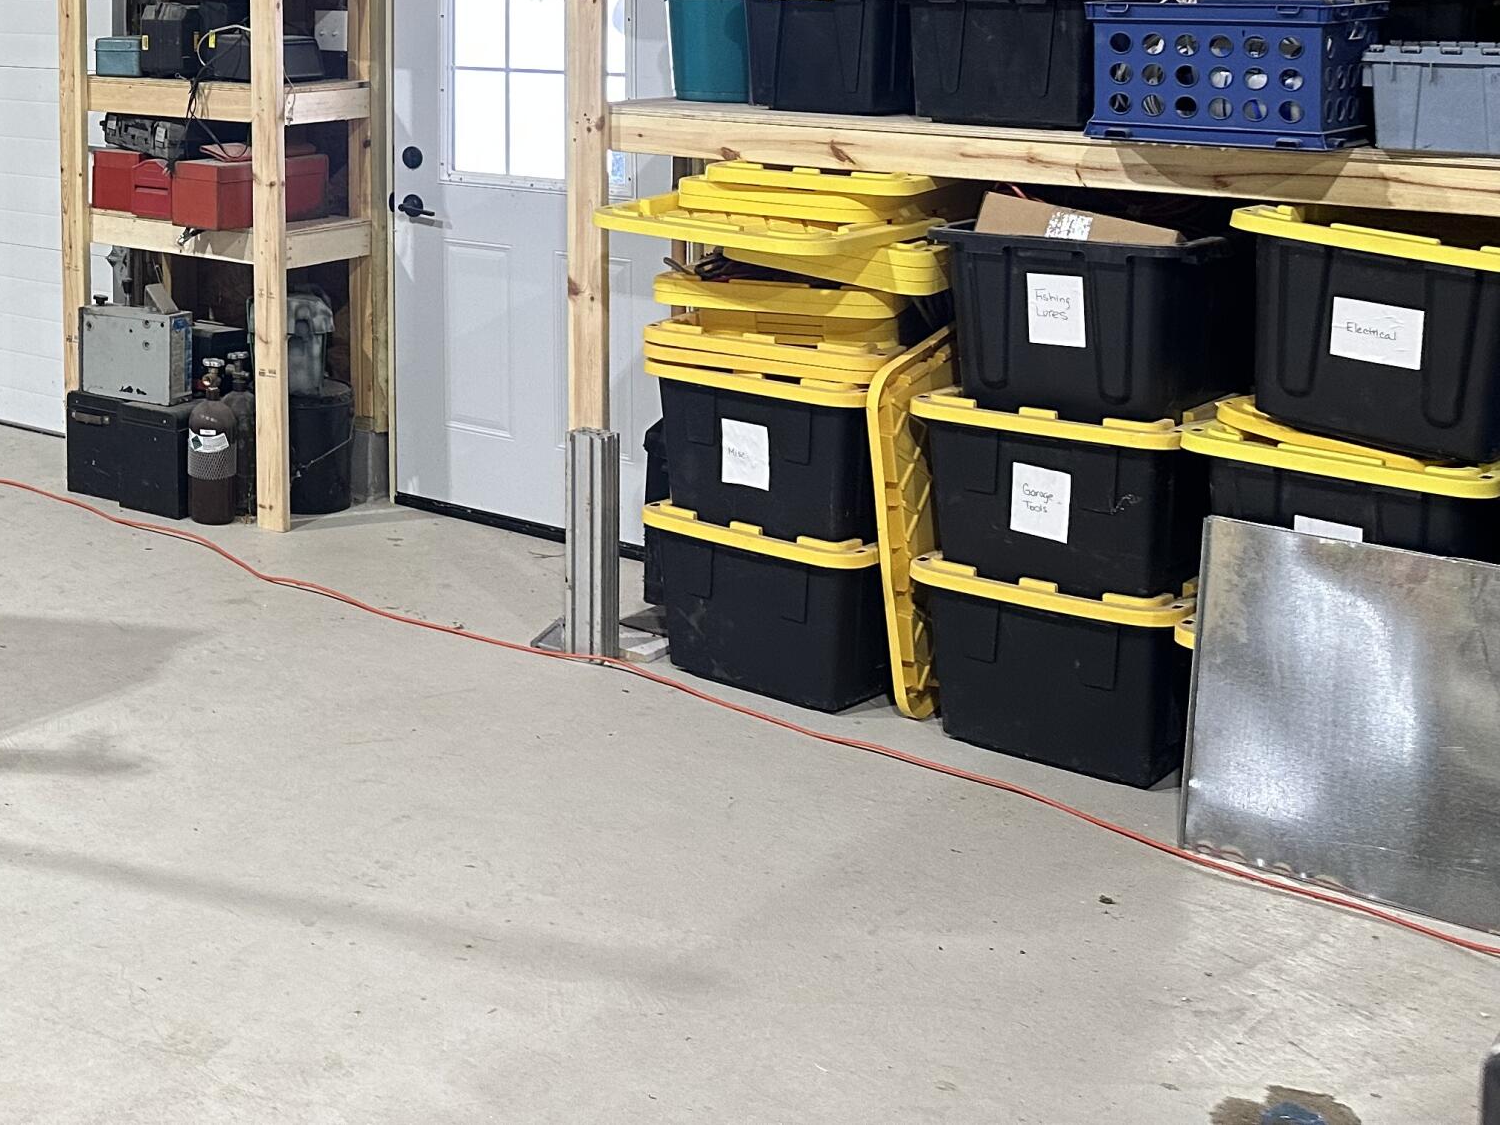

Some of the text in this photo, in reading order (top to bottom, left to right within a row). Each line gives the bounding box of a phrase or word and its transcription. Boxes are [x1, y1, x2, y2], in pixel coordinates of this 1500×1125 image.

[1034, 288, 1071, 310] Fishing
[1346, 321, 1397, 341] Electrical
[1022, 482, 1054, 504] Garage
[1022, 500, 1049, 514] Tools
